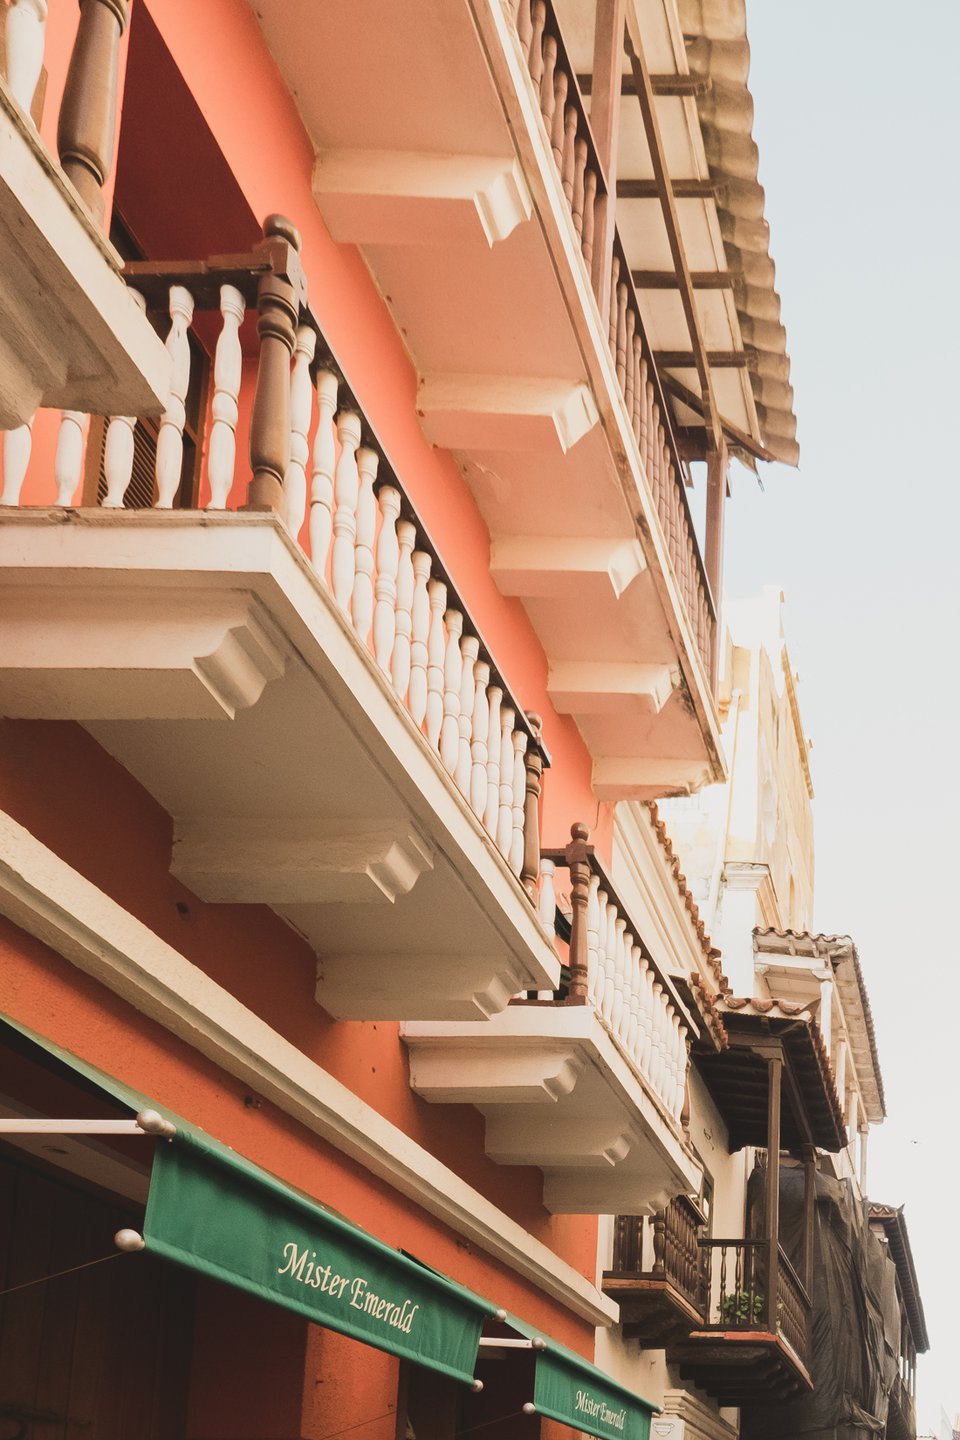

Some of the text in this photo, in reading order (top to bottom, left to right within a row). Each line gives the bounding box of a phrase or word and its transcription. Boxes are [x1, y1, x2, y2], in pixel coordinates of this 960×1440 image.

[278, 1243, 419, 1334] Mister Emerald
[575, 1390, 627, 1431] Mister Emerald
